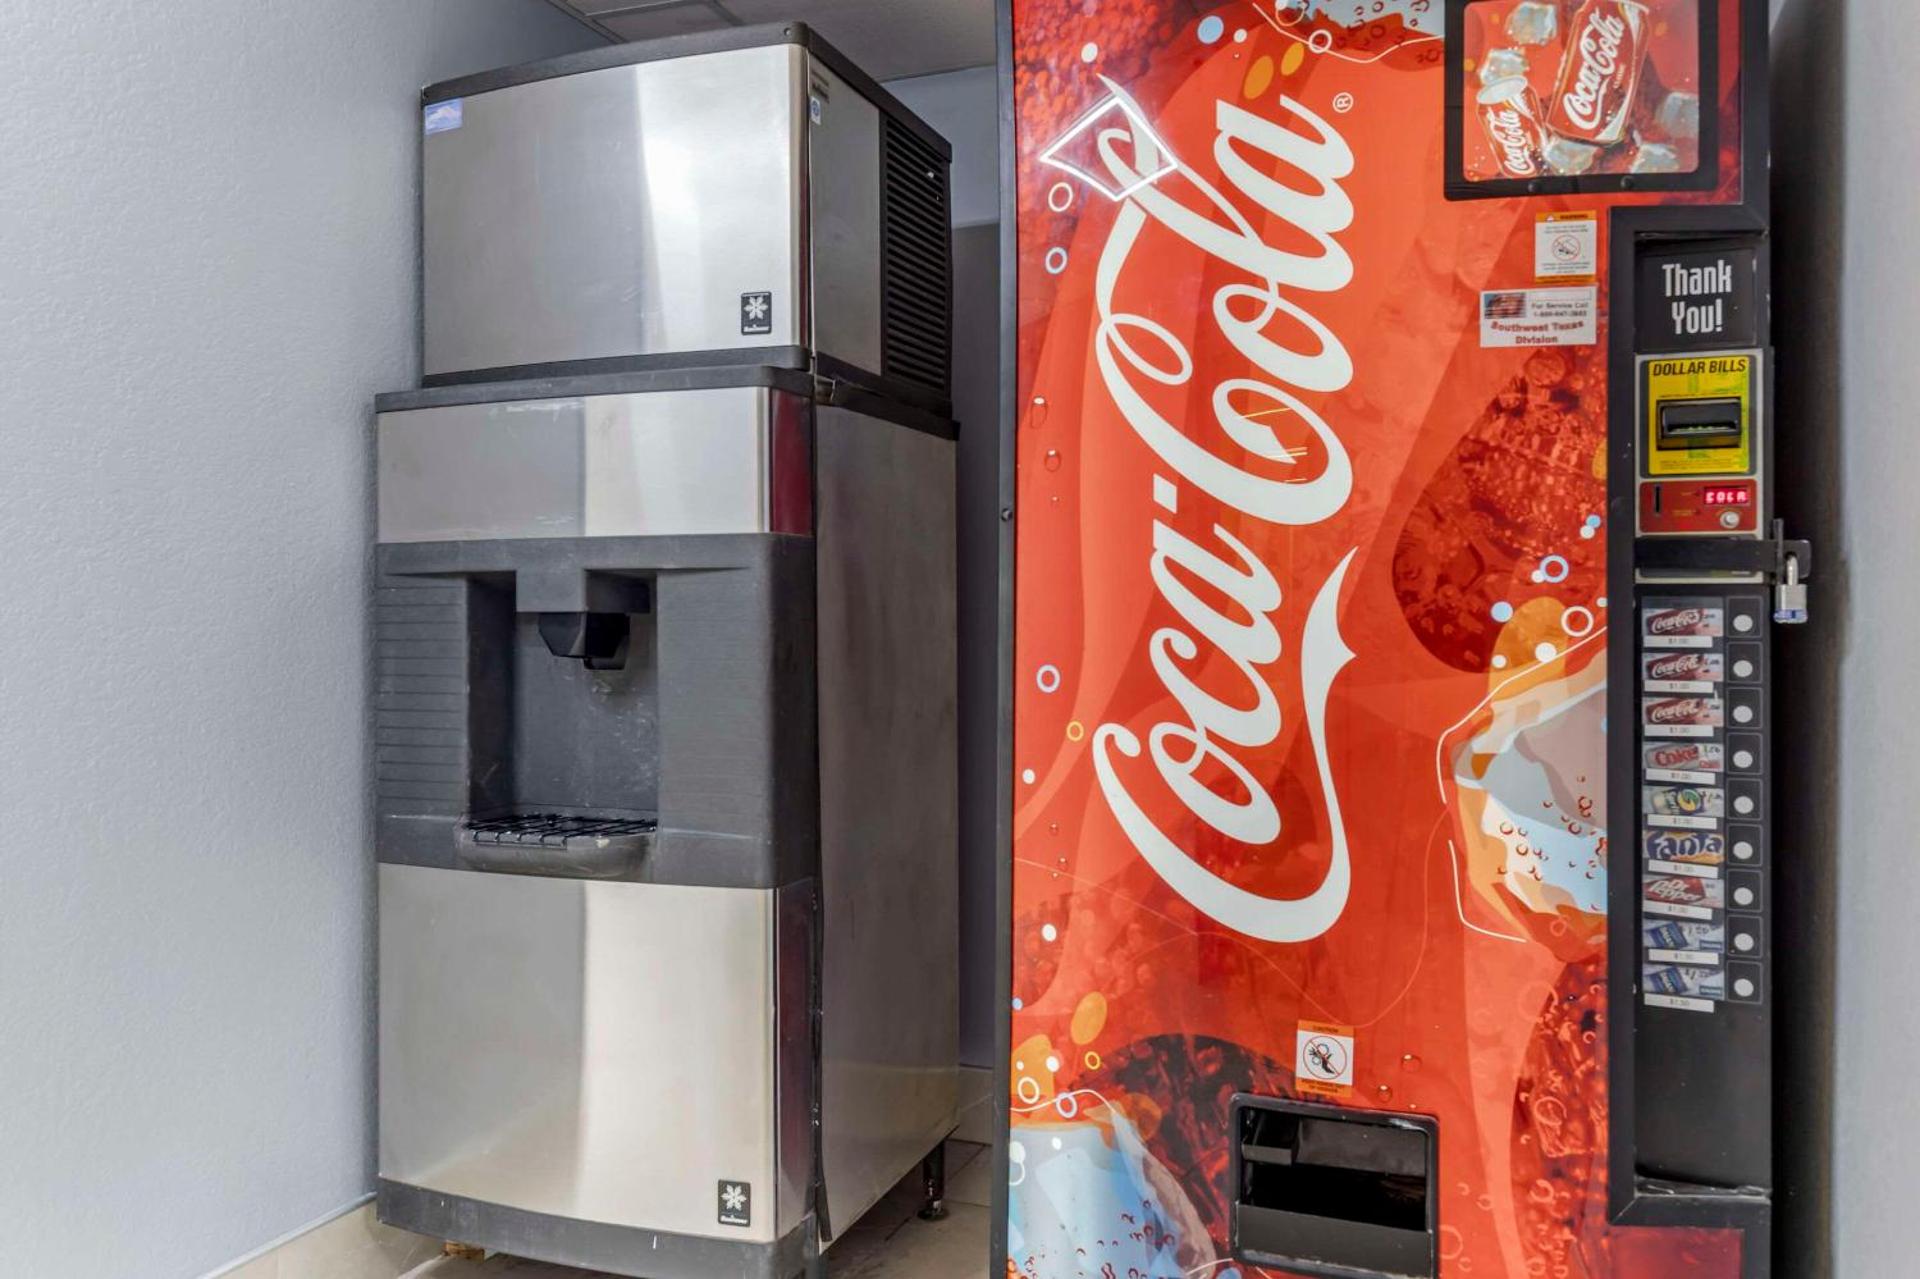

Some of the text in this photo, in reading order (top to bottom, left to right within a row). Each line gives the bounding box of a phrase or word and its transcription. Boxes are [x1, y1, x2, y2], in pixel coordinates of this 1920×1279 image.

[1662, 259, 1732, 297] Thank
[1491, 320, 1584, 332] Southwest Texas
[1671, 298, 1723, 335] You!
[1515, 335, 1558, 344] Division
[1653, 359, 1746, 376] DOLLAR BILLS
[1091, 73, 1358, 944] Coca-Cola
